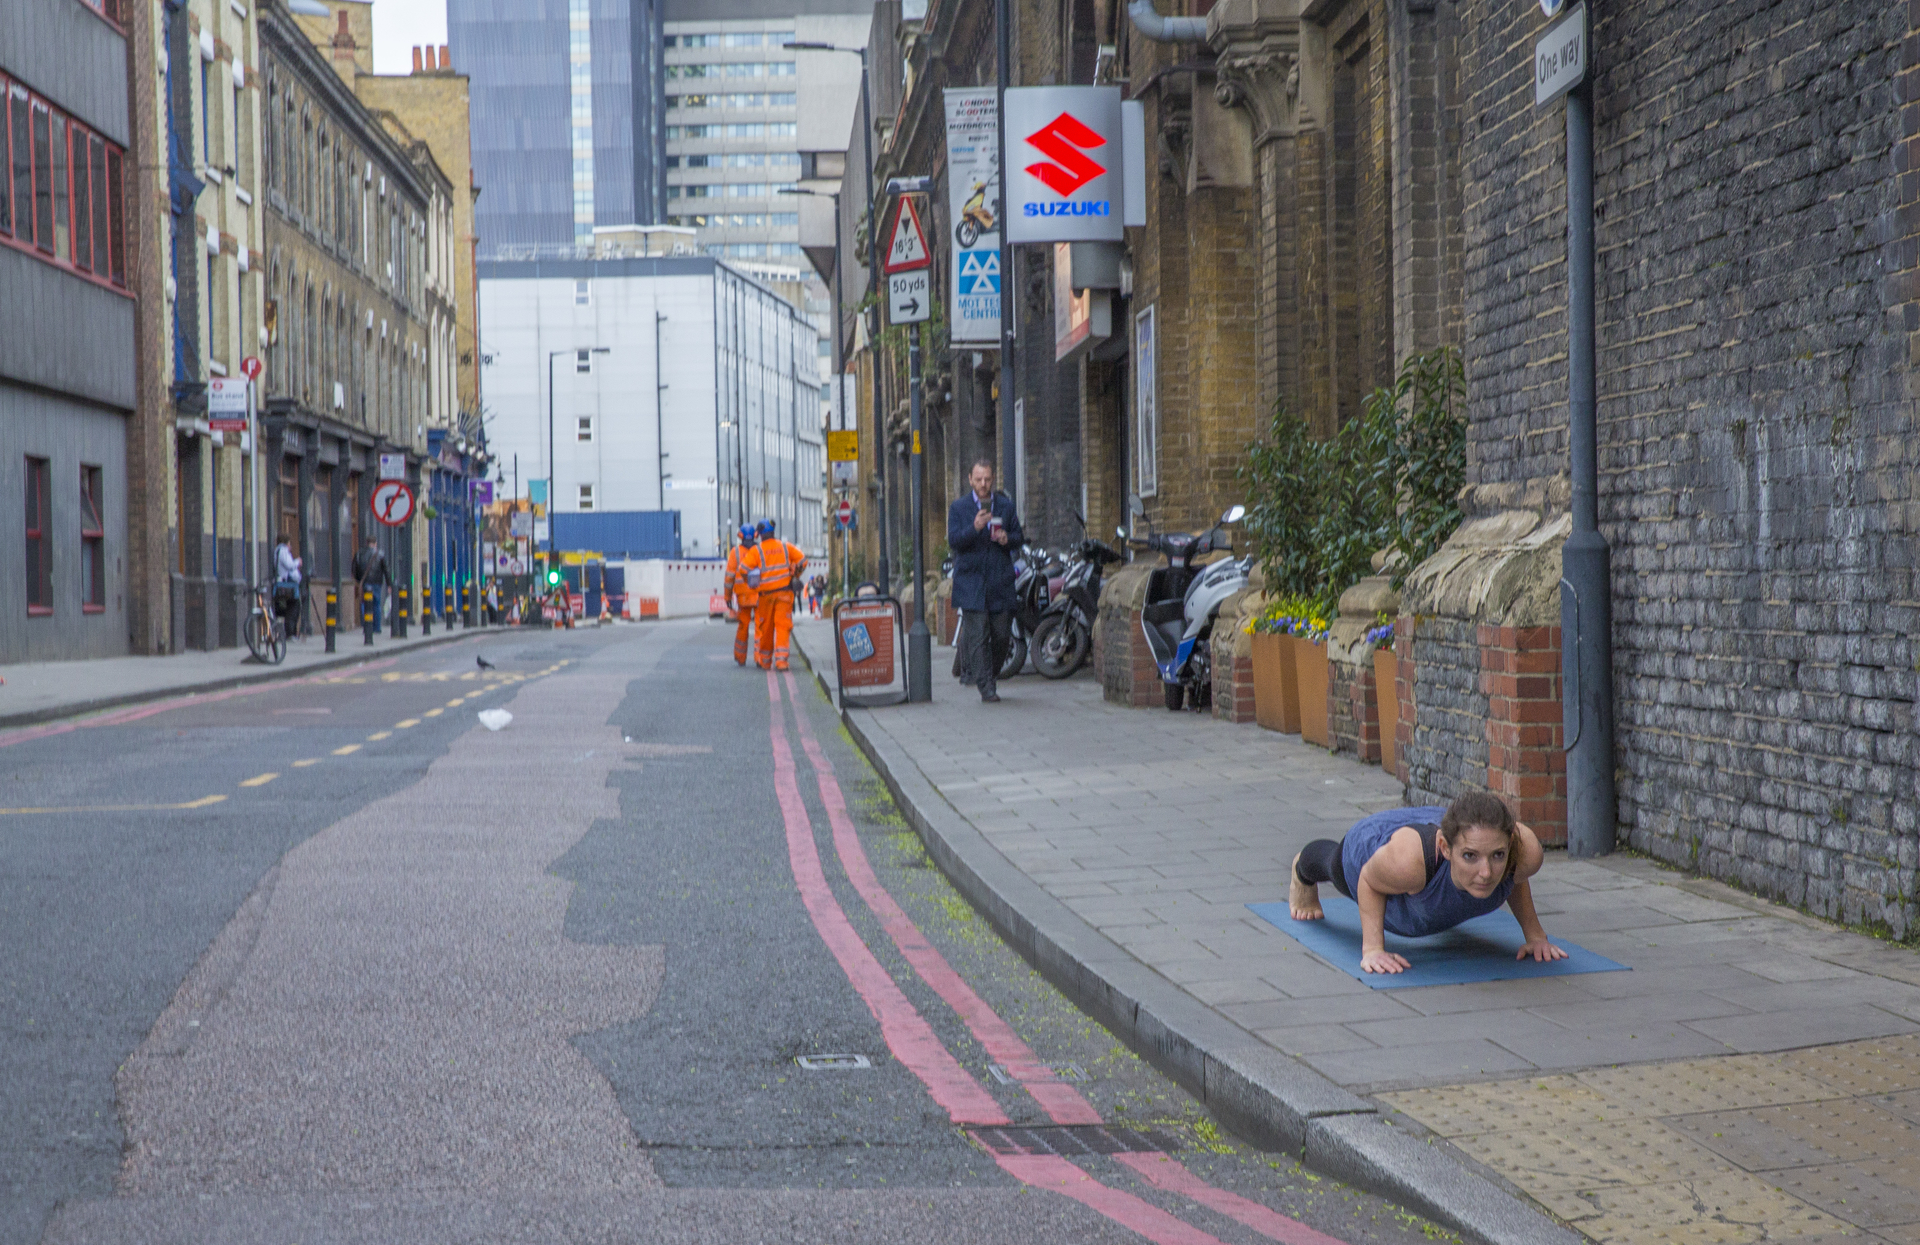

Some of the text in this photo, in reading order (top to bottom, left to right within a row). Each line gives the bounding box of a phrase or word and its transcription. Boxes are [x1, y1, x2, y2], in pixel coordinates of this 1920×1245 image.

[1539, 34, 1580, 85] One way
[959, 98, 995, 108] LONDON
[949, 121, 998, 131] MOTORCYCL
[1023, 201, 1110, 217] SUZUKI
[893, 276, 925, 294] 50 yds
[958, 296, 1001, 309] MOT TES
